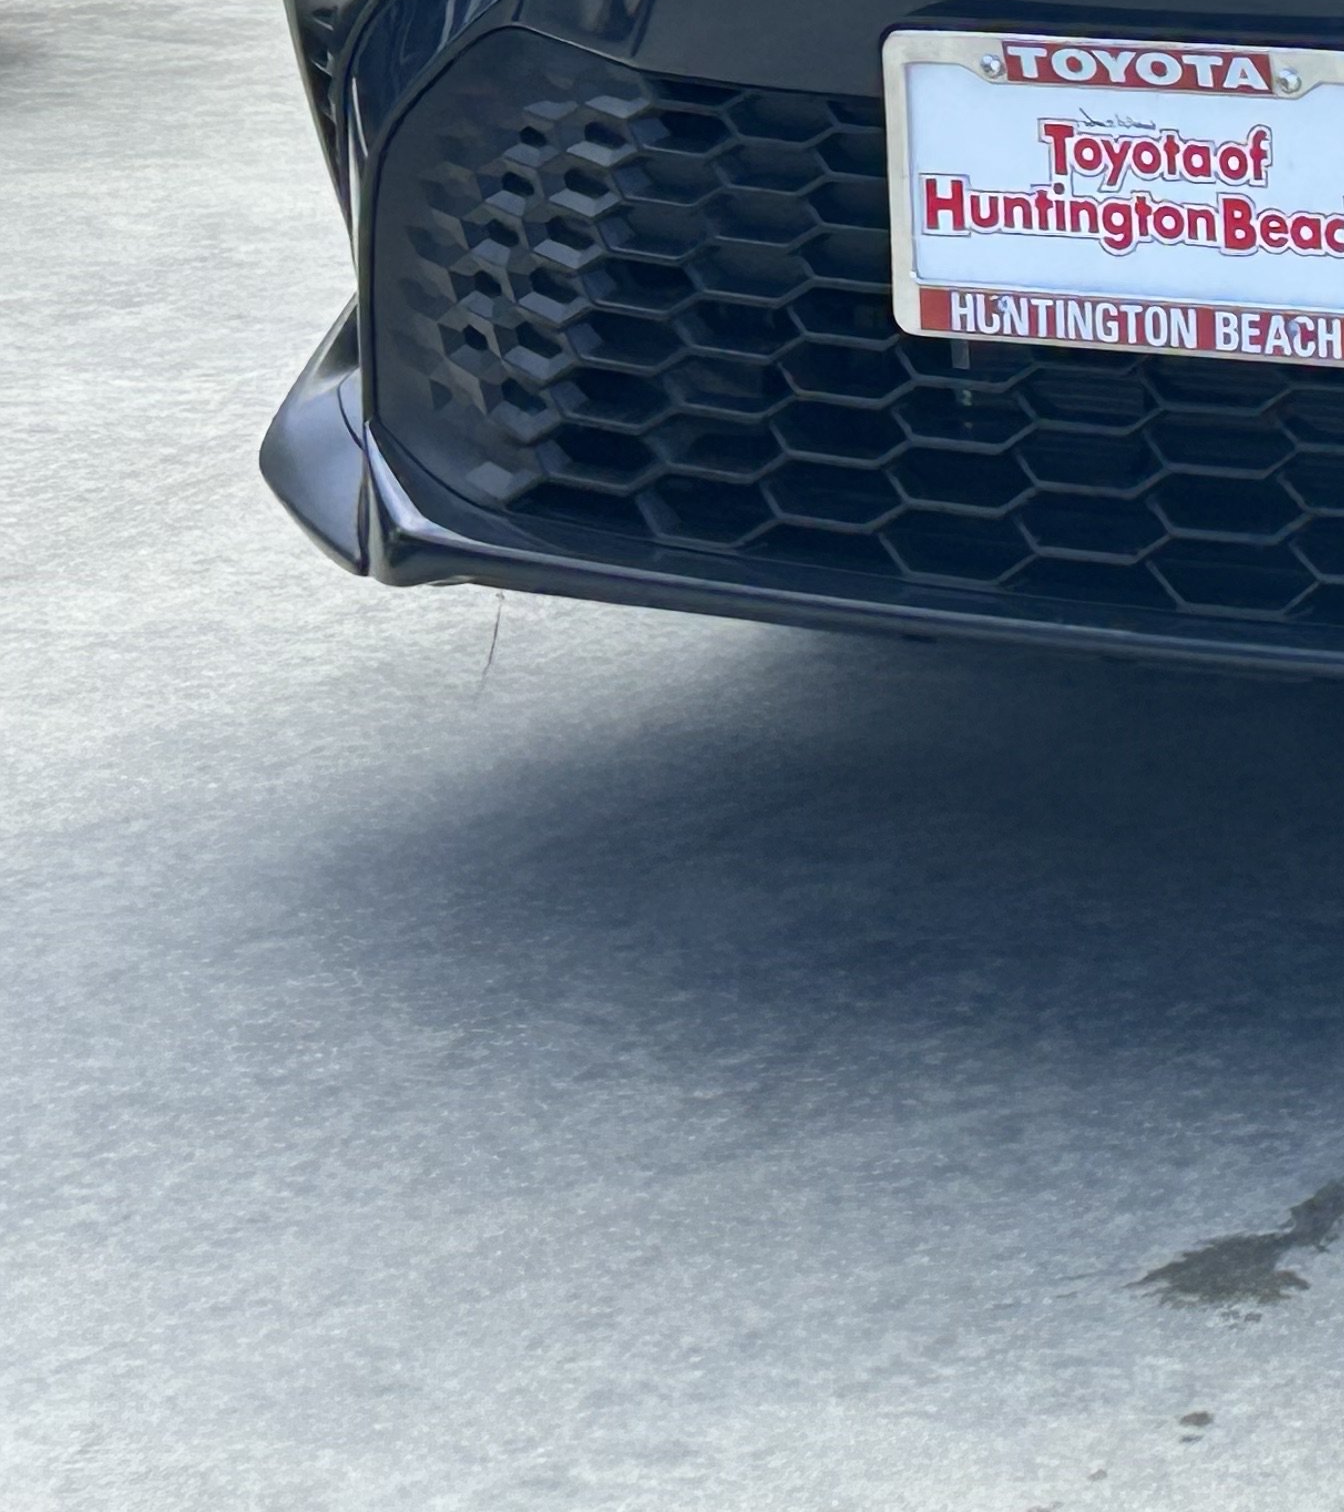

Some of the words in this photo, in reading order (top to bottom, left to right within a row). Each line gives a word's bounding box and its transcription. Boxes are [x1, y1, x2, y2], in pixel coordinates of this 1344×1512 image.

[1006, 45, 1270, 91] TOYOTA
[1044, 123, 1213, 186] Toyota
[1218, 130, 1268, 181] of
[925, 177, 1216, 250] Huntington
[950, 291, 1197, 349] HUNTINGTON
[1214, 311, 1342, 360] BEACH
